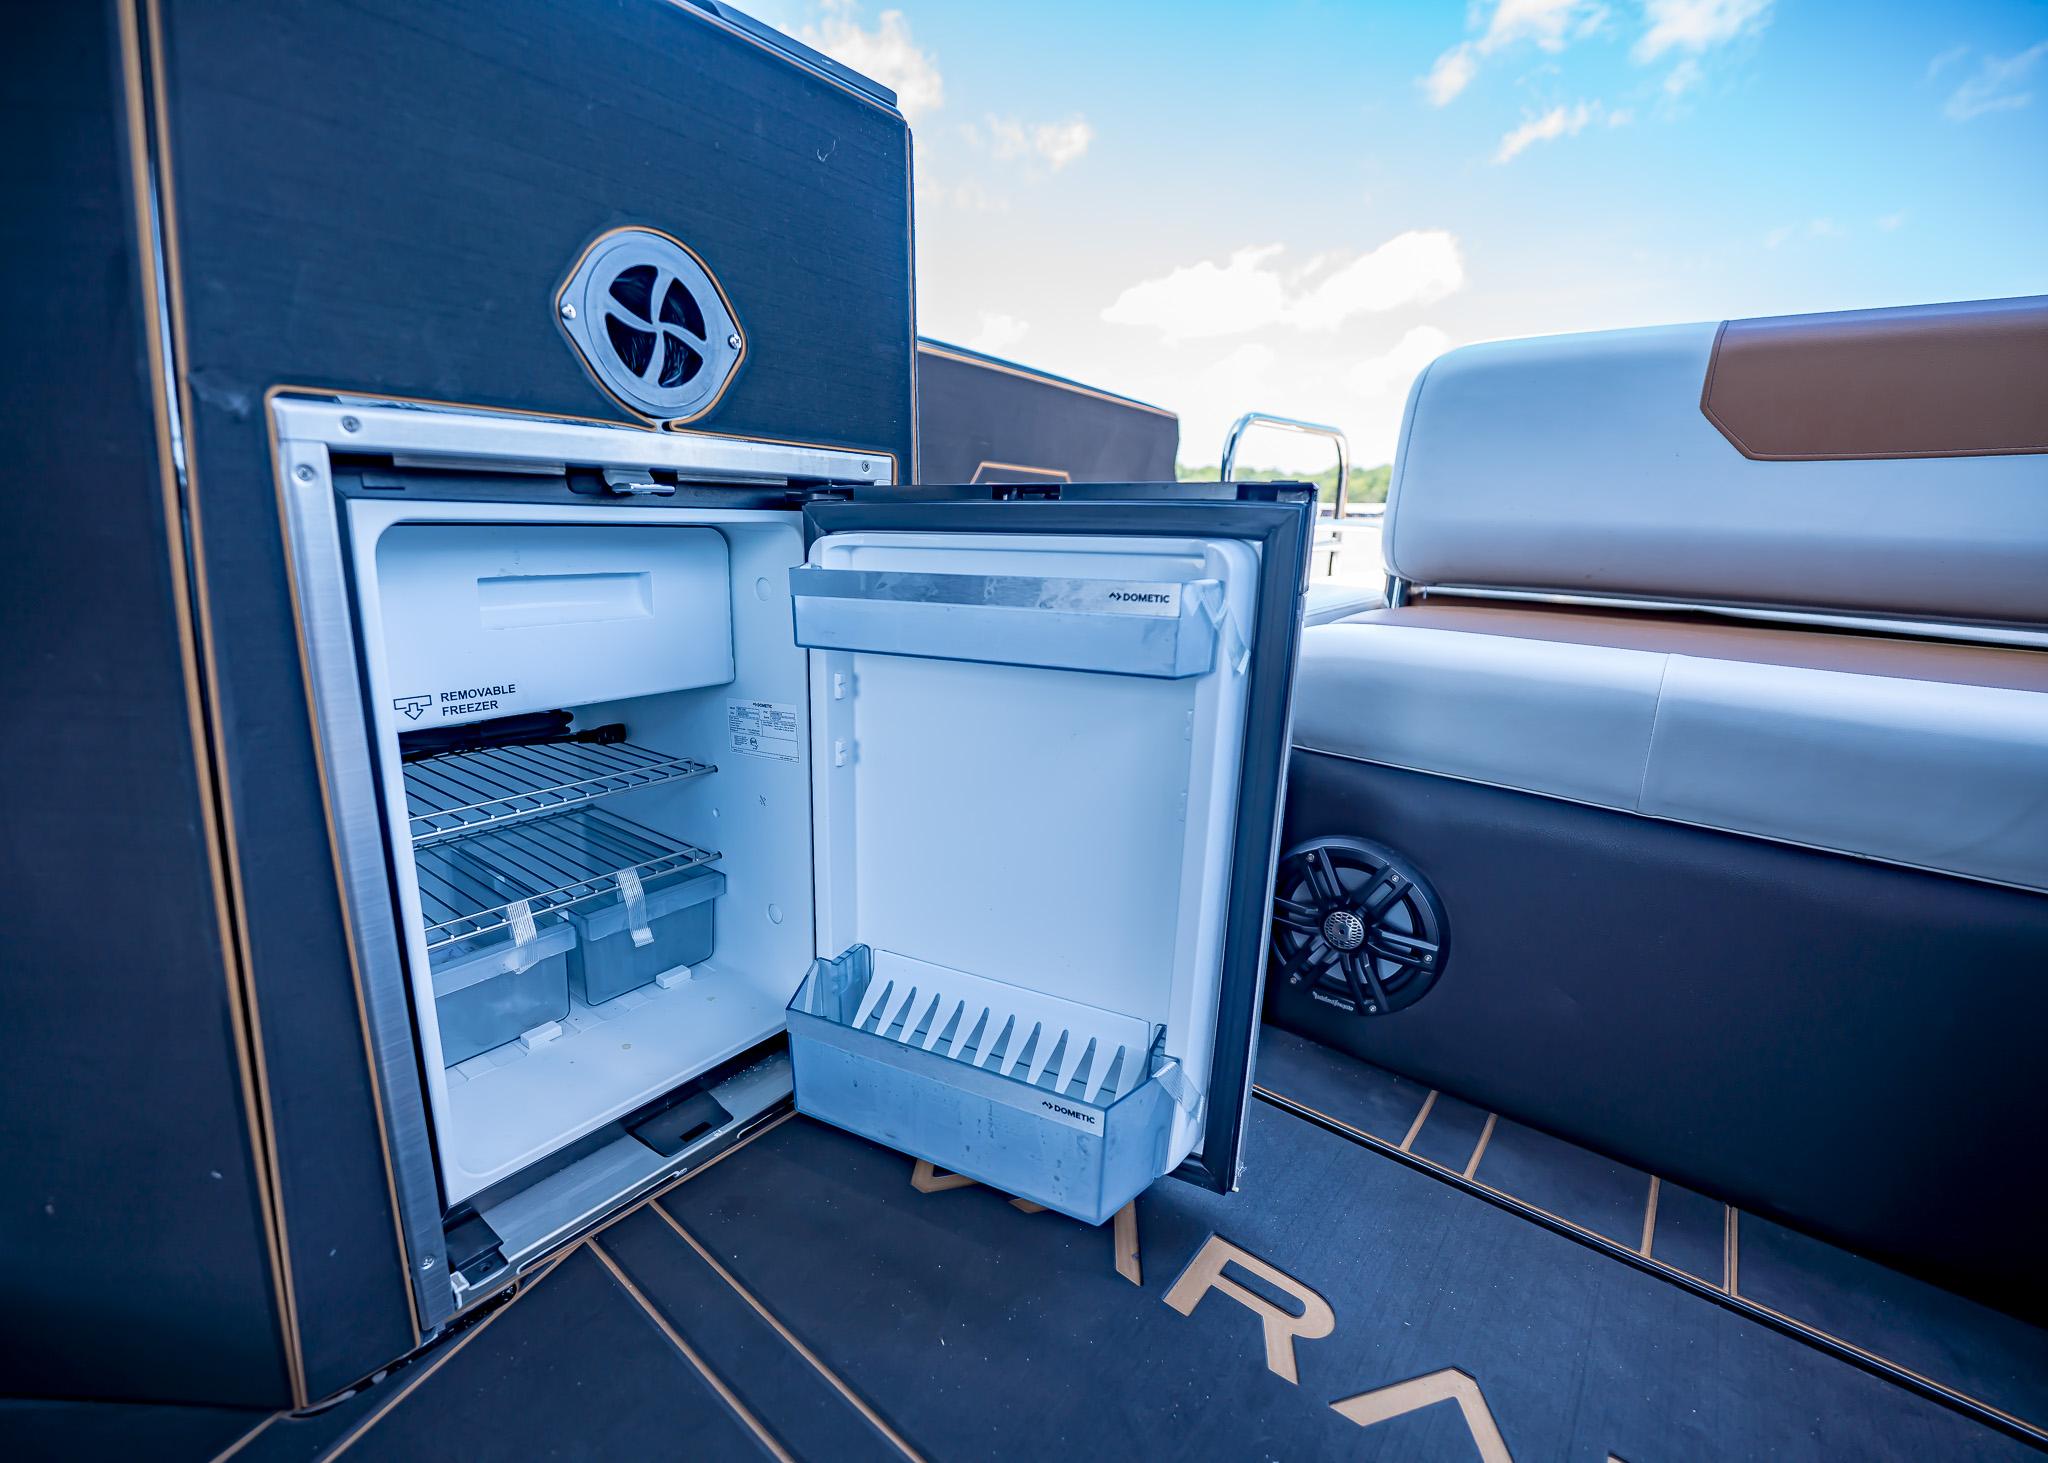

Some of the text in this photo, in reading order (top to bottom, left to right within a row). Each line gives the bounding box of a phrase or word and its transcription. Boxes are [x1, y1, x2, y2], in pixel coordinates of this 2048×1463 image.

[1123, 593, 1170, 603] DOMETIC
[440, 684, 516, 702] REMOVABLE
[442, 700, 498, 716] FREEZER
[1054, 1104, 1095, 1124] DOMETIC
